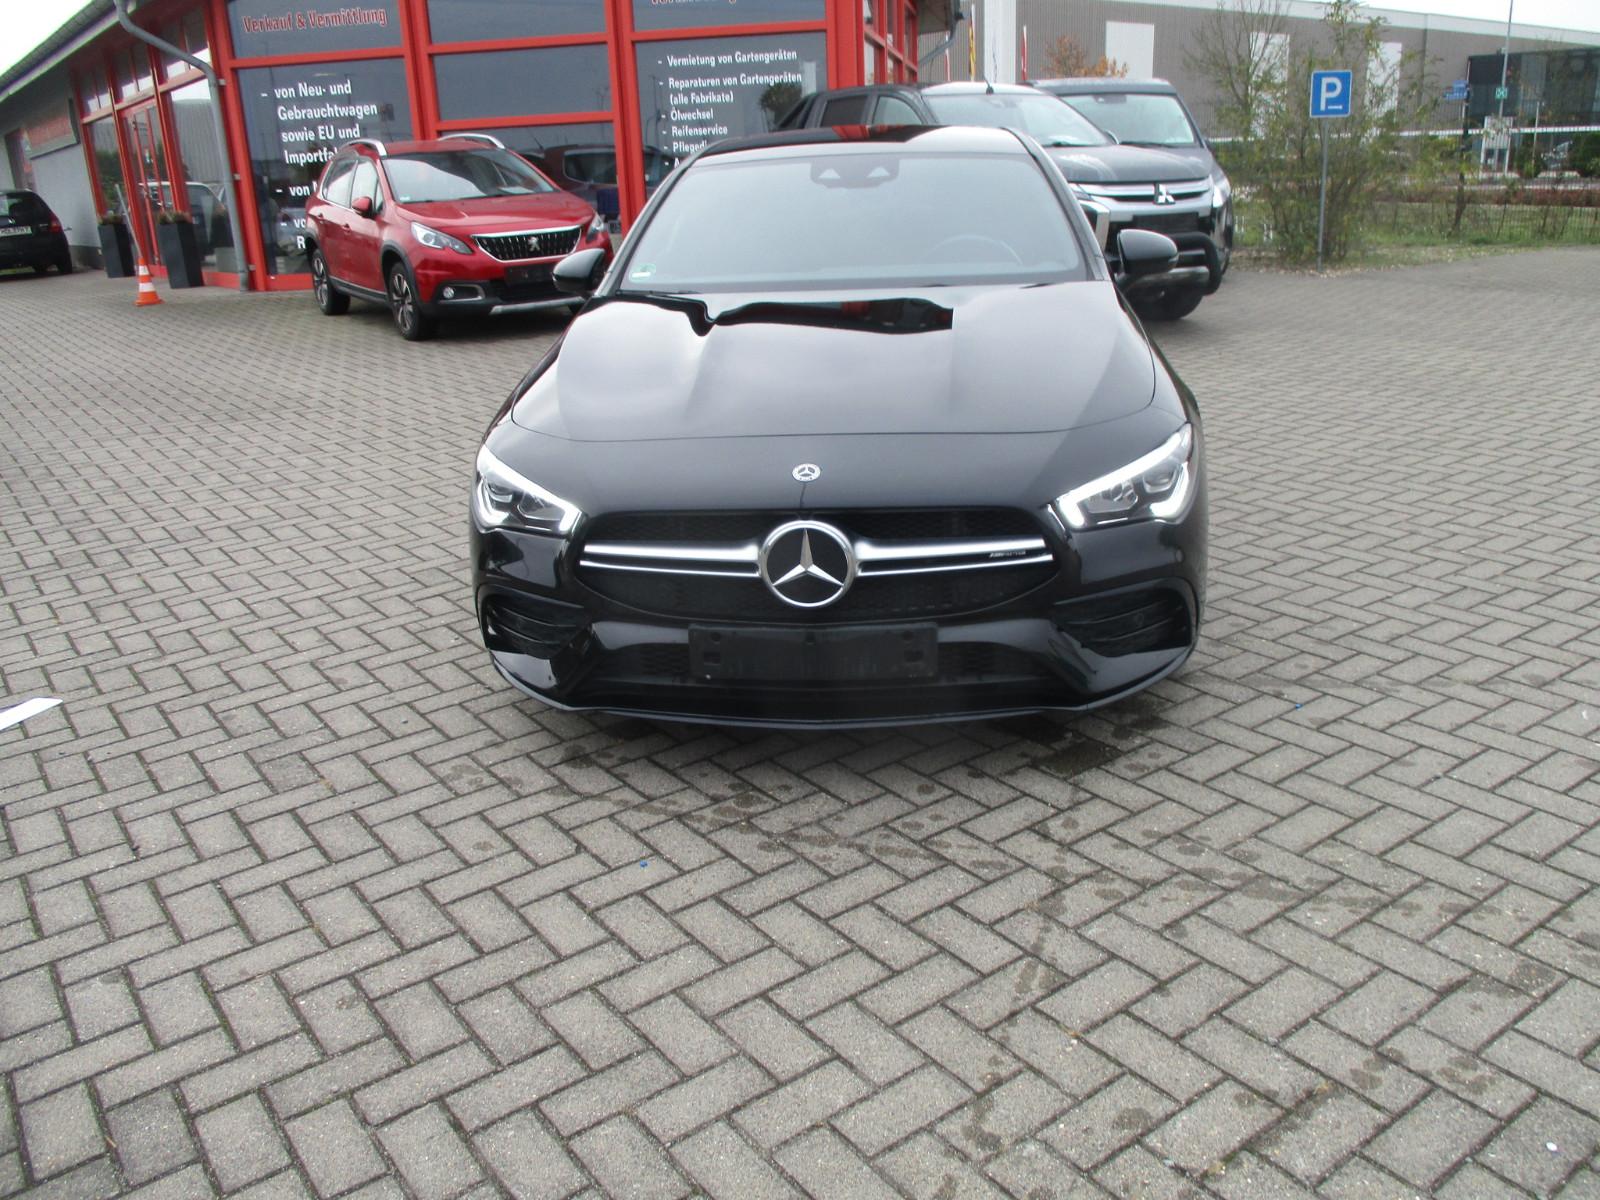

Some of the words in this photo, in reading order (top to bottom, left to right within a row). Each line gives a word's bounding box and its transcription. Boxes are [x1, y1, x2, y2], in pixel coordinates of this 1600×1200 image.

[243, 14, 293, 33] Verkauf
[296, 13, 305, 28] &
[309, 7, 388, 29] Vermittlung
[667, 55, 715, 67] Vermietung
[718, 54, 733, 63] von
[735, 49, 797, 63] Gartengeräten
[274, 86, 295, 98] von
[298, 82, 326, 97] Neu-
[330, 80, 352, 95] und
[669, 77, 720, 90] Reparaturen
[723, 76, 738, 86] von
[740, 72, 802, 86] Gartengeräten
[670, 94, 689, 105] (alle
[691, 91, 734, 103] Fabrikate)
[1320, 77, 1342, 111] P
[278, 102, 378, 120] Gebrauchtwagen
[670, 107, 714, 121] Ölwechsel
[281, 128, 315, 142] sowie
[318, 125, 335, 140] EU
[339, 124, 361, 138] und
[672, 124, 728, 137] Reifenservice
[289, 185, 310, 196] von
